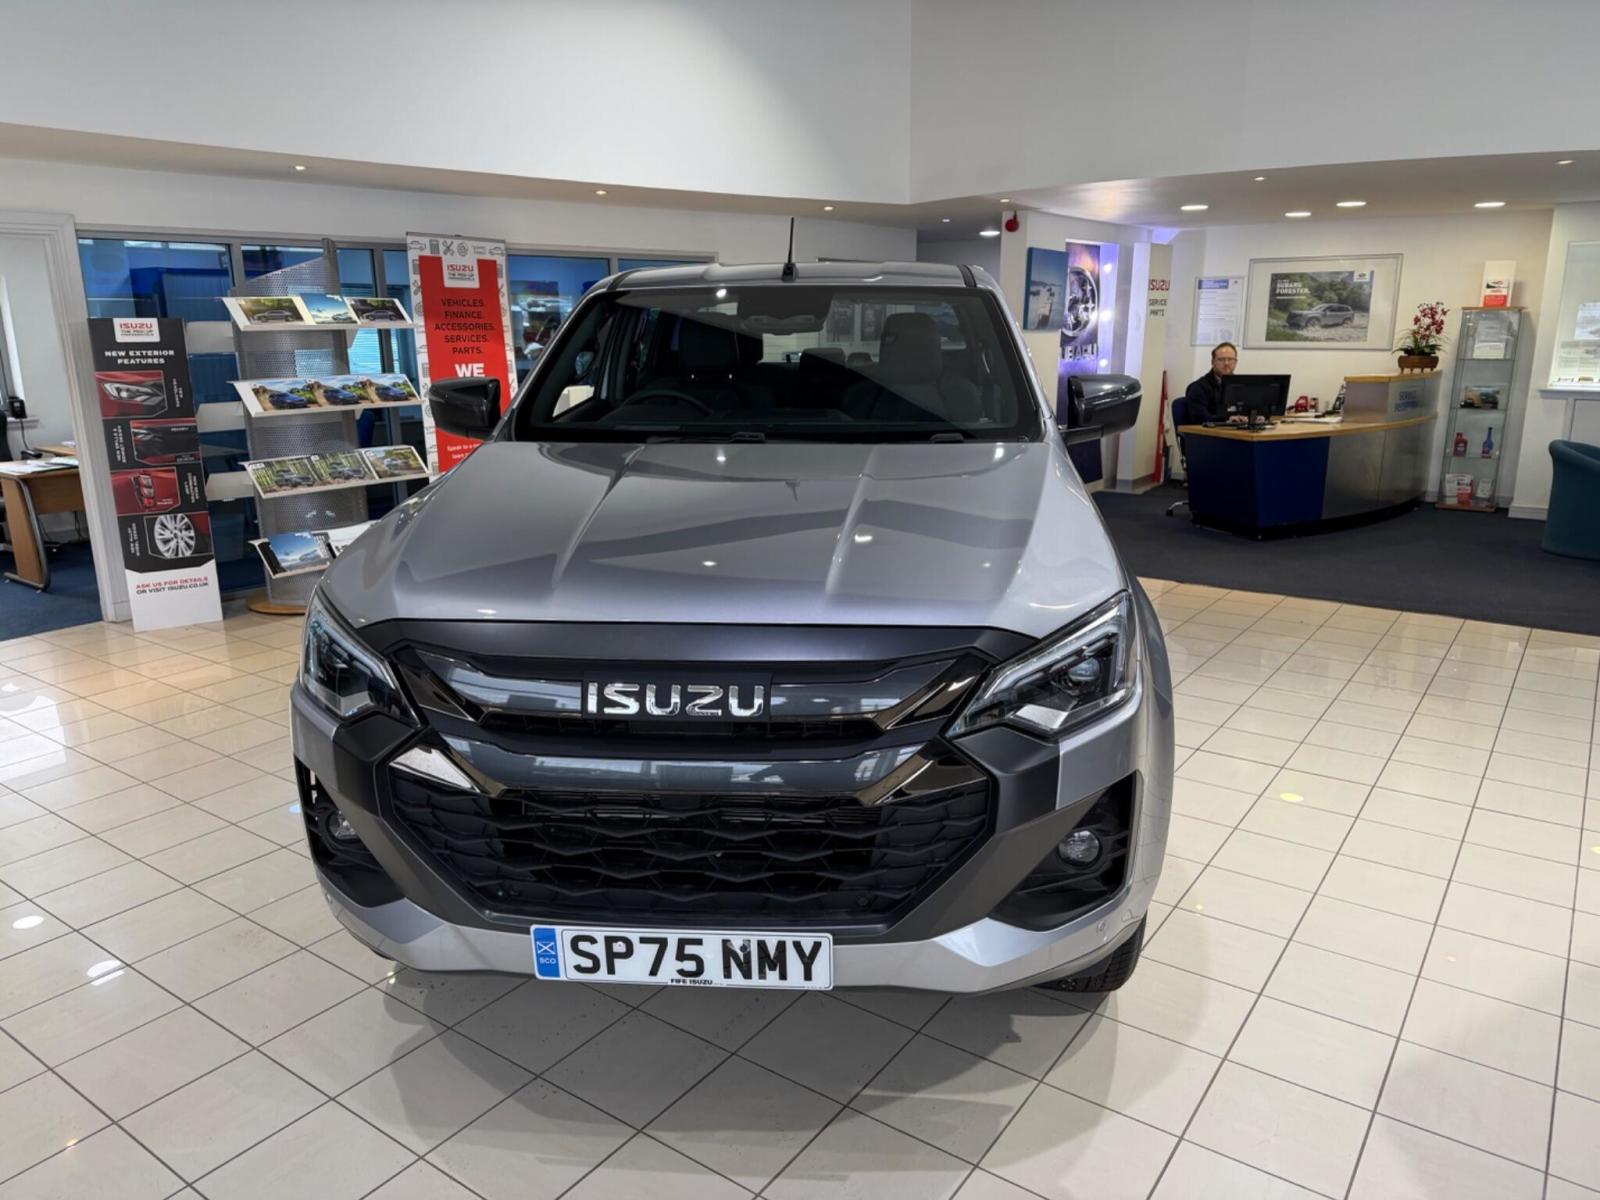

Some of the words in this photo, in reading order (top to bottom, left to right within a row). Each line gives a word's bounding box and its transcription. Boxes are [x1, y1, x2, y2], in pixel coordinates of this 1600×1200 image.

[446, 264, 474, 272] ISUZU
[128, 349, 175, 357] EXTERIOR
[455, 363, 485, 377] WE
[179, 576, 209, 584] DETAILS
[587, 682, 765, 717] ISUZU
[569, 934, 705, 978] SP75
[721, 938, 823, 982] NMY
